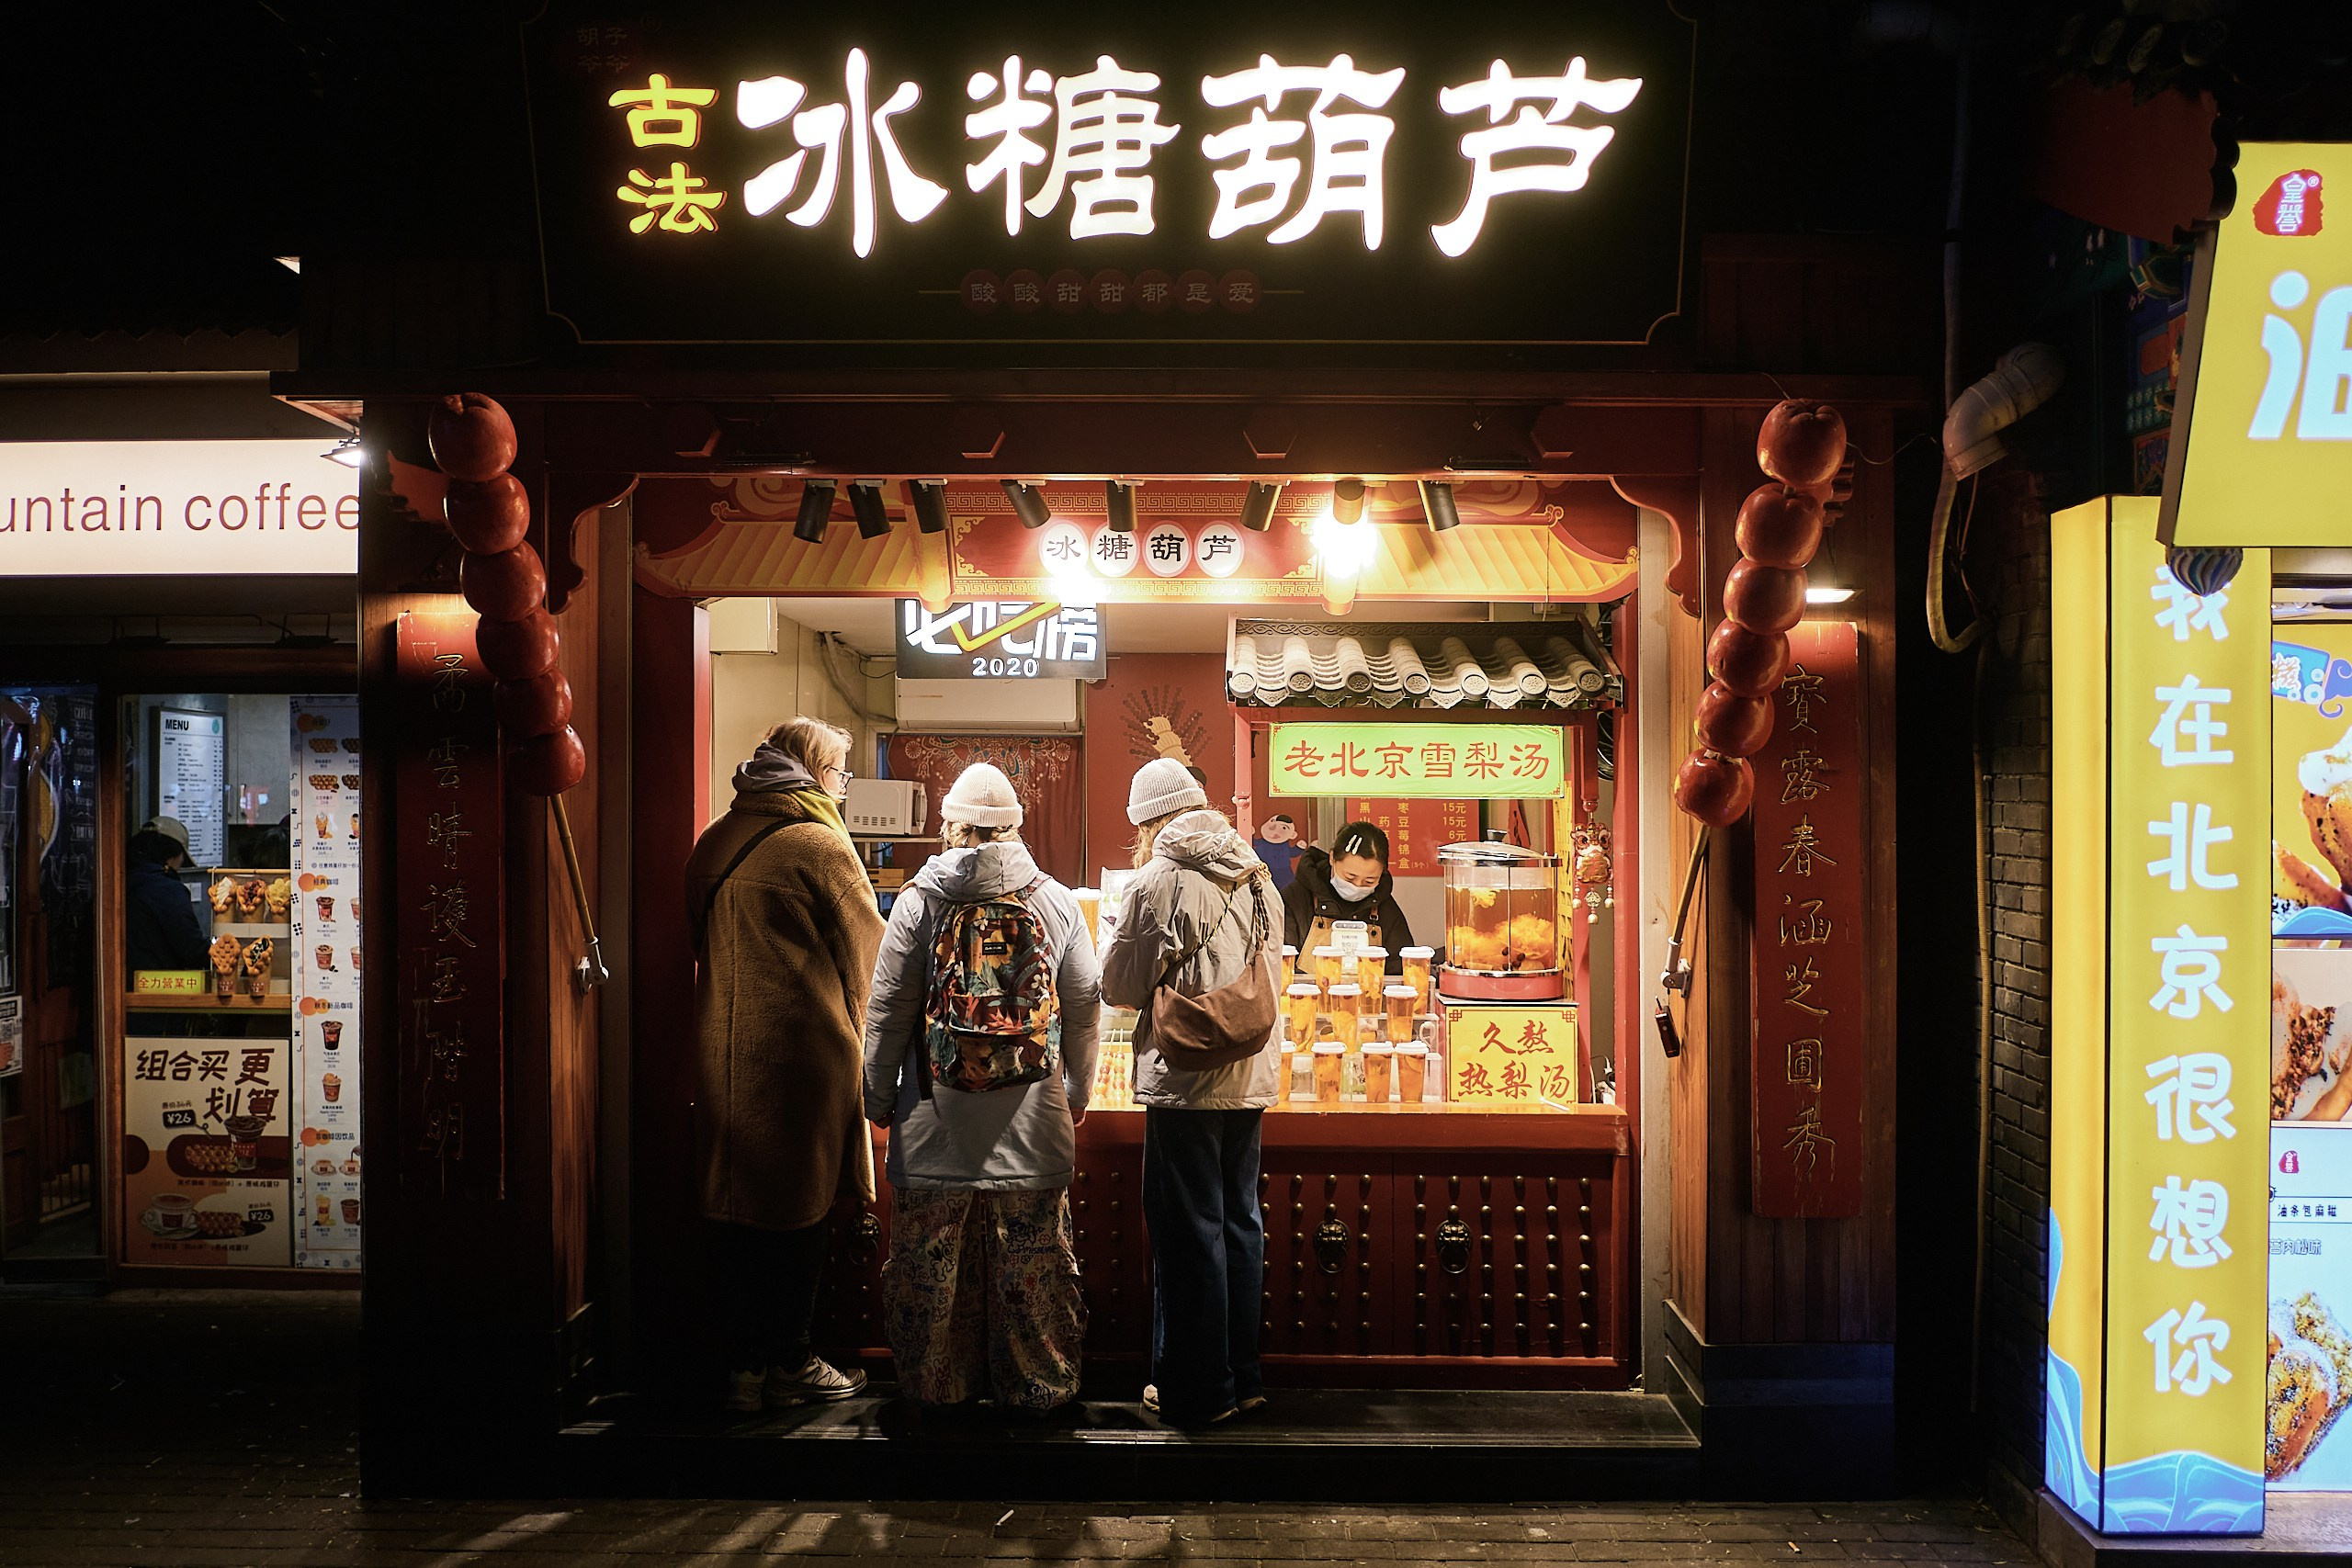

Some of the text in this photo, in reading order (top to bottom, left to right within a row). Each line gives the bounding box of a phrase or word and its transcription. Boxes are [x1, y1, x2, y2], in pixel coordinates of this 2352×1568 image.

[607, 73, 727, 235] 古法
[736, 47, 1644, 258] 冰糖葫芦
[970, 280, 1255, 305] 酸酸甜甜都是爱
[184, 482, 361, 531] coffee
[1046, 533, 1237, 562] 冰糖葫芦
[971, 656, 1040, 678] 2020
[164, 718, 189, 731] MENU
[1283, 739, 1551, 780] 老北京雪梨汤
[1442, 802, 1467, 814] 15元
[1442, 817, 1467, 829] 15元
[1448, 830, 1467, 841] 6元
[138, 976, 198, 990] 全力營業中
[2146, 564, 2239, 1396] 我在北京很想你
[1478, 1019, 1555, 1055] 久熬
[1457, 1060, 1571, 1100] 热梨汤
[166, 1112, 193, 1124] ¥26
[203, 1088, 280, 1125] 划算
